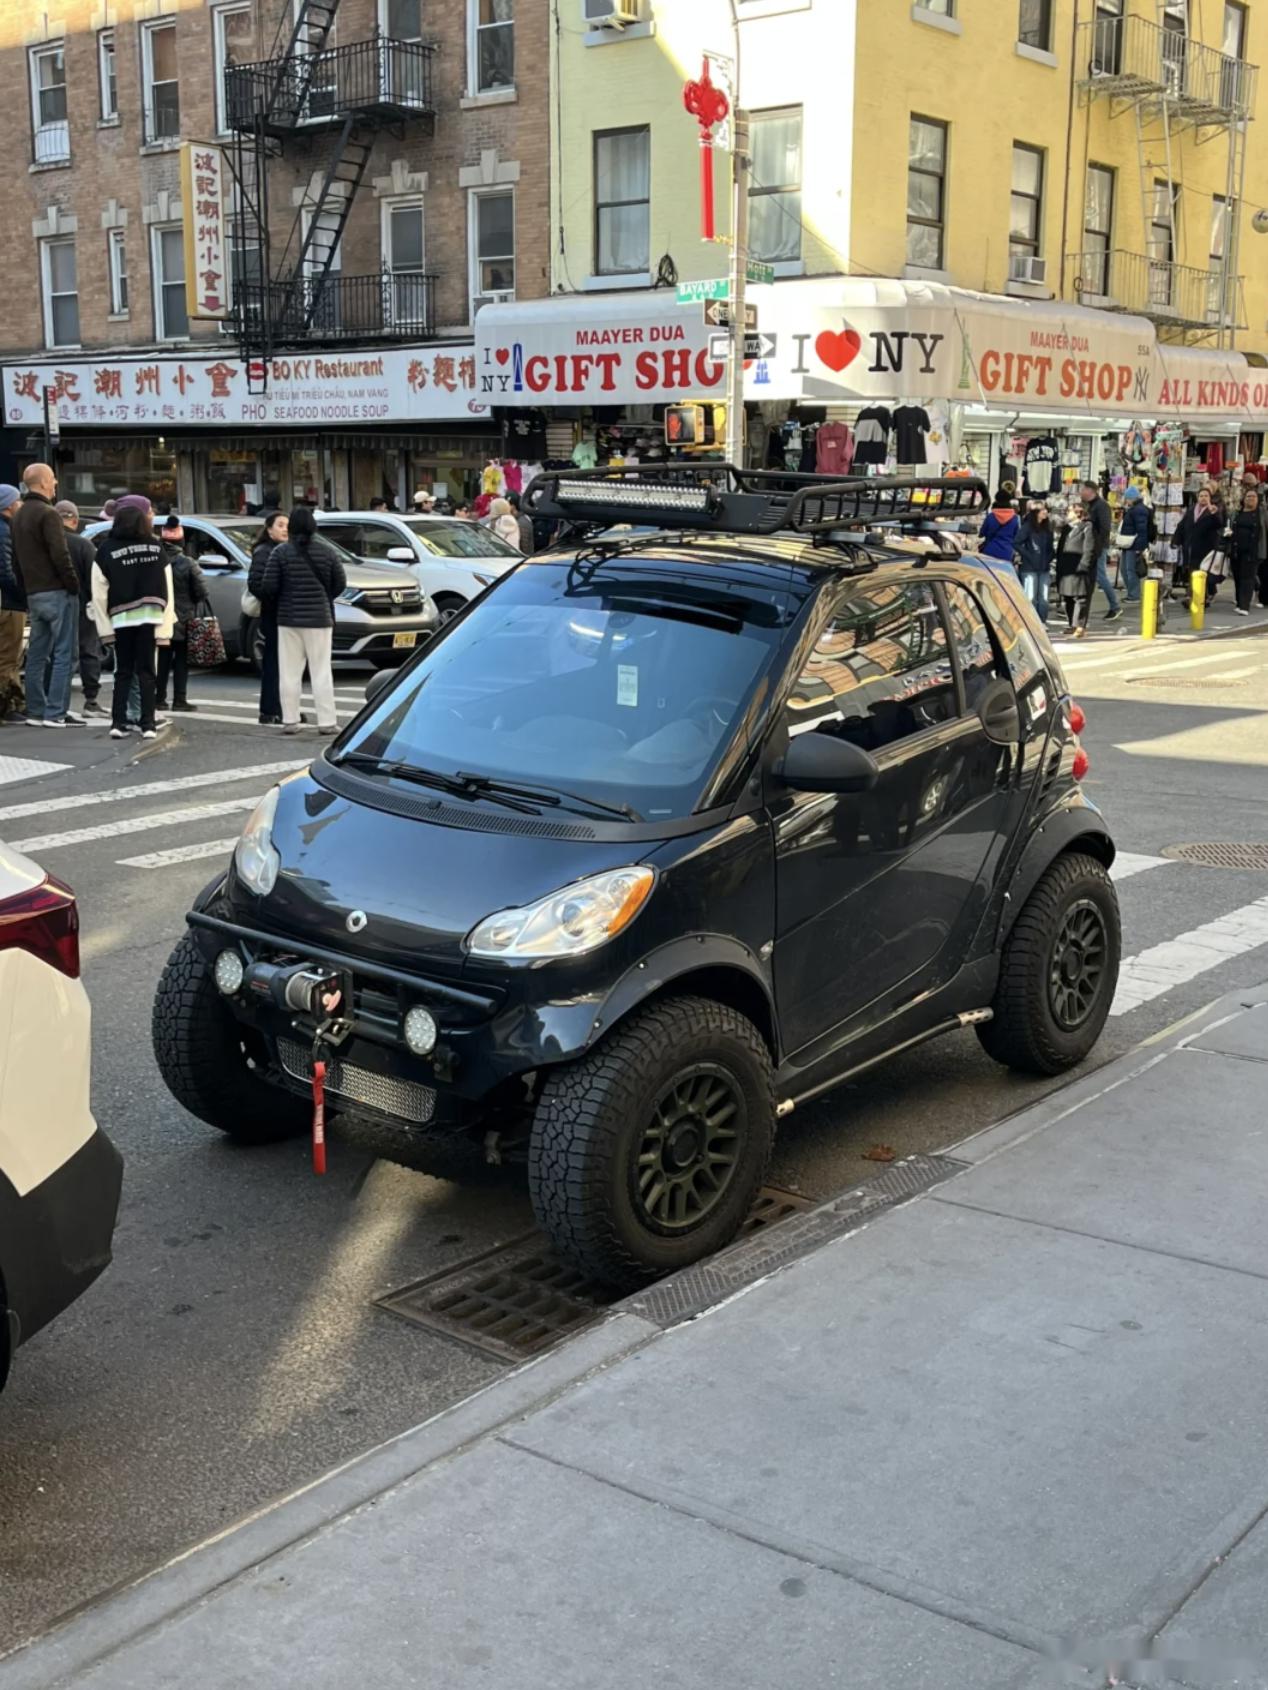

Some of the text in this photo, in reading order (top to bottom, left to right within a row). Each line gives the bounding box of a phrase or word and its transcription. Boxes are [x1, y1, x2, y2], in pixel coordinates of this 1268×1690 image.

[680, 280, 717, 296] BAYARD
[576, 325, 686, 345] MAAYER DUA
[1030, 331, 1089, 352] MAAYER DUA
[484, 348, 491, 365] I
[791, 331, 944, 373] I NY
[272, 357, 384, 380] BO KY Restaurant
[525, 353, 622, 392] GIFT
[980, 350, 1132, 402] GIFT SHOP
[481, 375, 511, 392] NY
[1158, 379, 1192, 405] ALL
[1197, 381, 1249, 407] KINDS
[274, 406, 319, 419] SEAFOOD
[321, 405, 360, 418] NOODLE
[362, 404, 389, 418] SOUP
